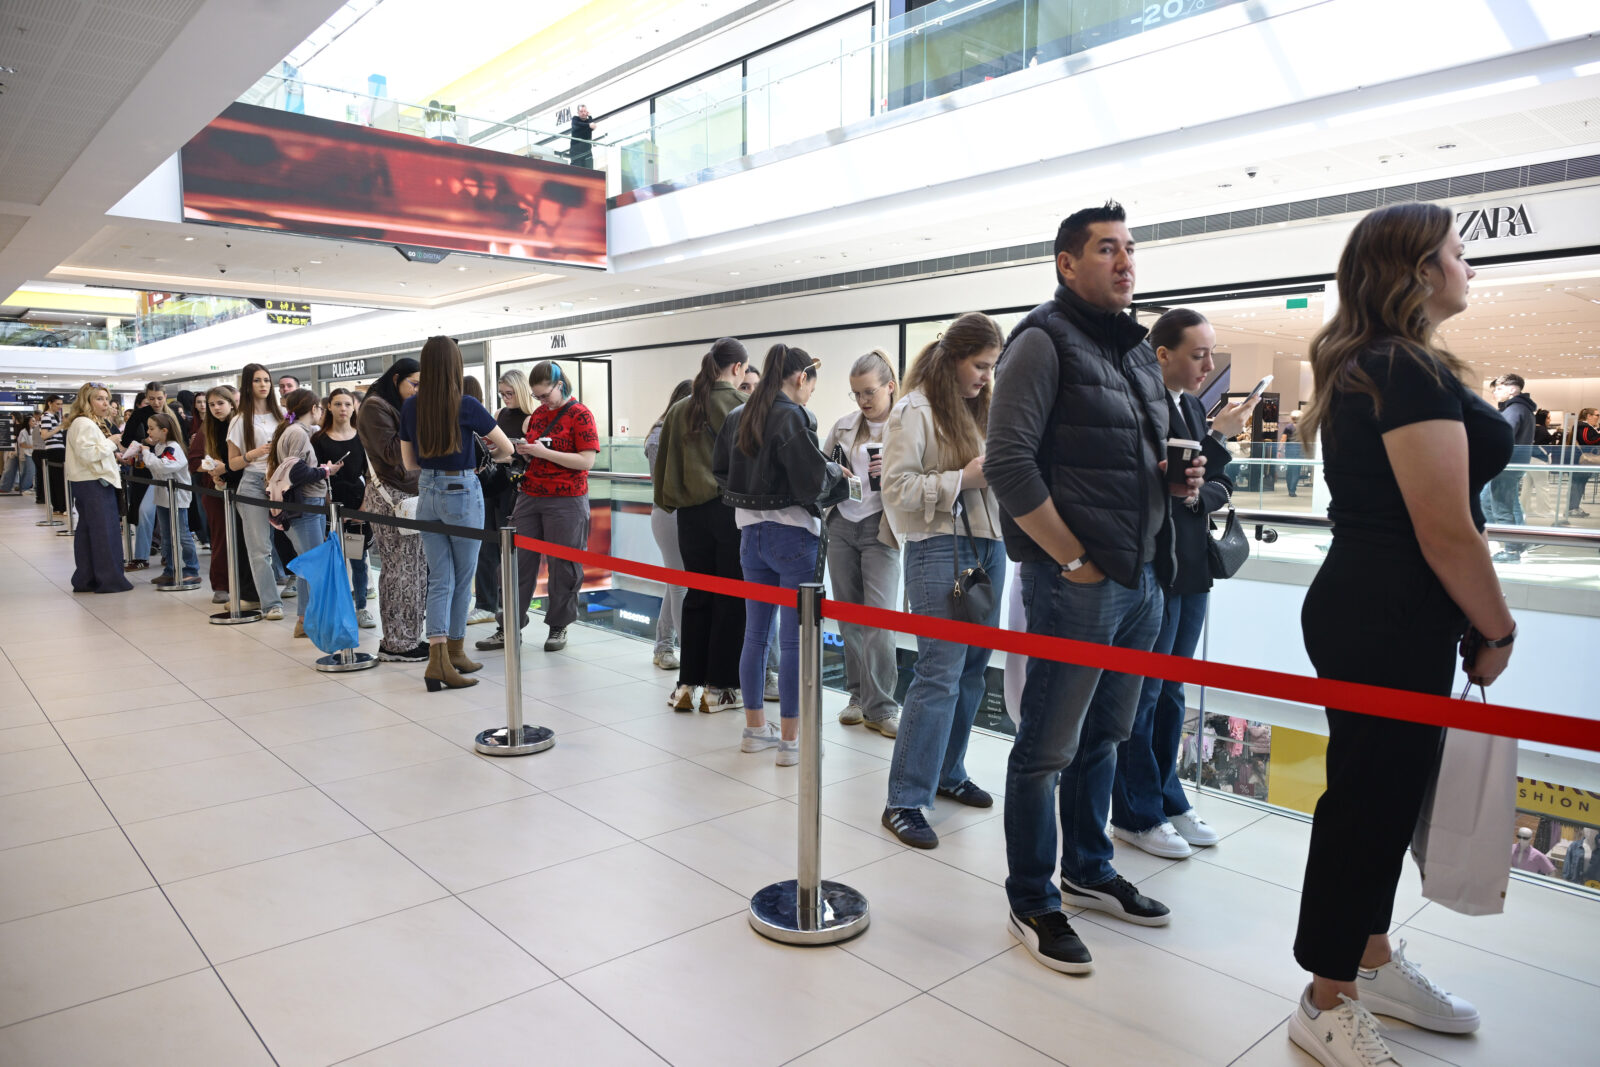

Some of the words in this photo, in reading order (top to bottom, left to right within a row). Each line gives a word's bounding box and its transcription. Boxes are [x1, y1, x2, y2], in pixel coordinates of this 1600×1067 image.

[1456, 203, 1538, 241] ZARA
[332, 359, 366, 378] PULL&BEAR
[1519, 788, 1590, 812] SHION
